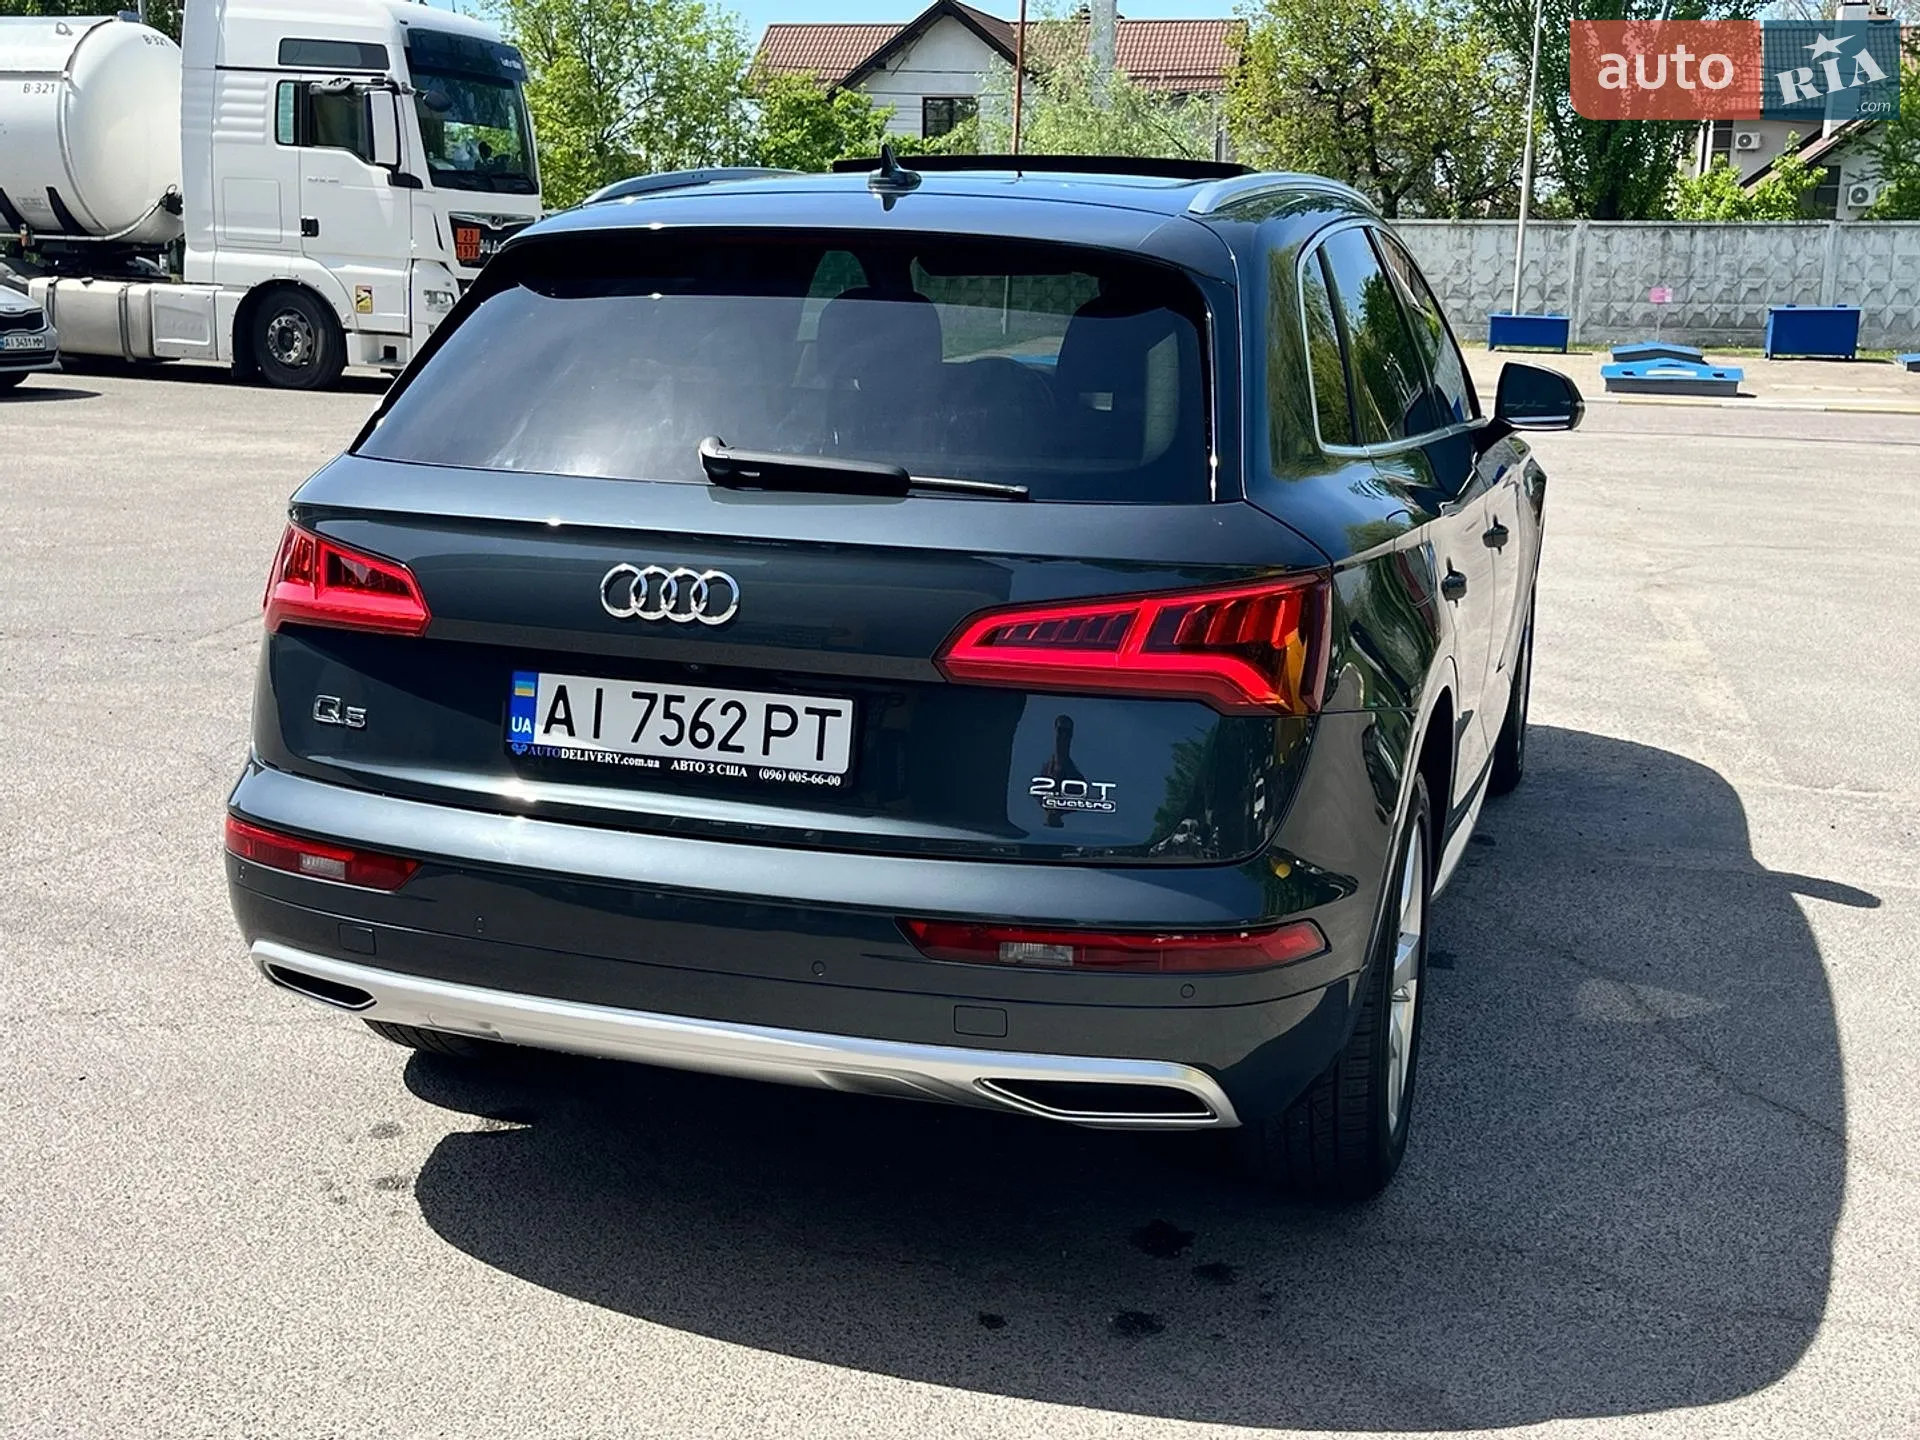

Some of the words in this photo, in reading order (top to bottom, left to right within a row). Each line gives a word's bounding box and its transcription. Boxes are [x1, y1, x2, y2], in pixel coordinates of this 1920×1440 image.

[463, 230, 474, 242] 23
[313, 695, 367, 728] Q5
[511, 716, 533, 735] UA
[543, 684, 603, 740] AI
[631, 691, 747, 753] 7562
[762, 703, 842, 762] PT
[528, 745, 660, 768] AUTODELIVERY.com.ua
[670, 760, 705, 774] АВТО
[716, 764, 748, 778] США
[758, 767, 787, 782] (096)
[788, 770, 842, 787] 005-66-00
[1029, 777, 1116, 801] 2.0T
[1046, 798, 1113, 810] quattro
